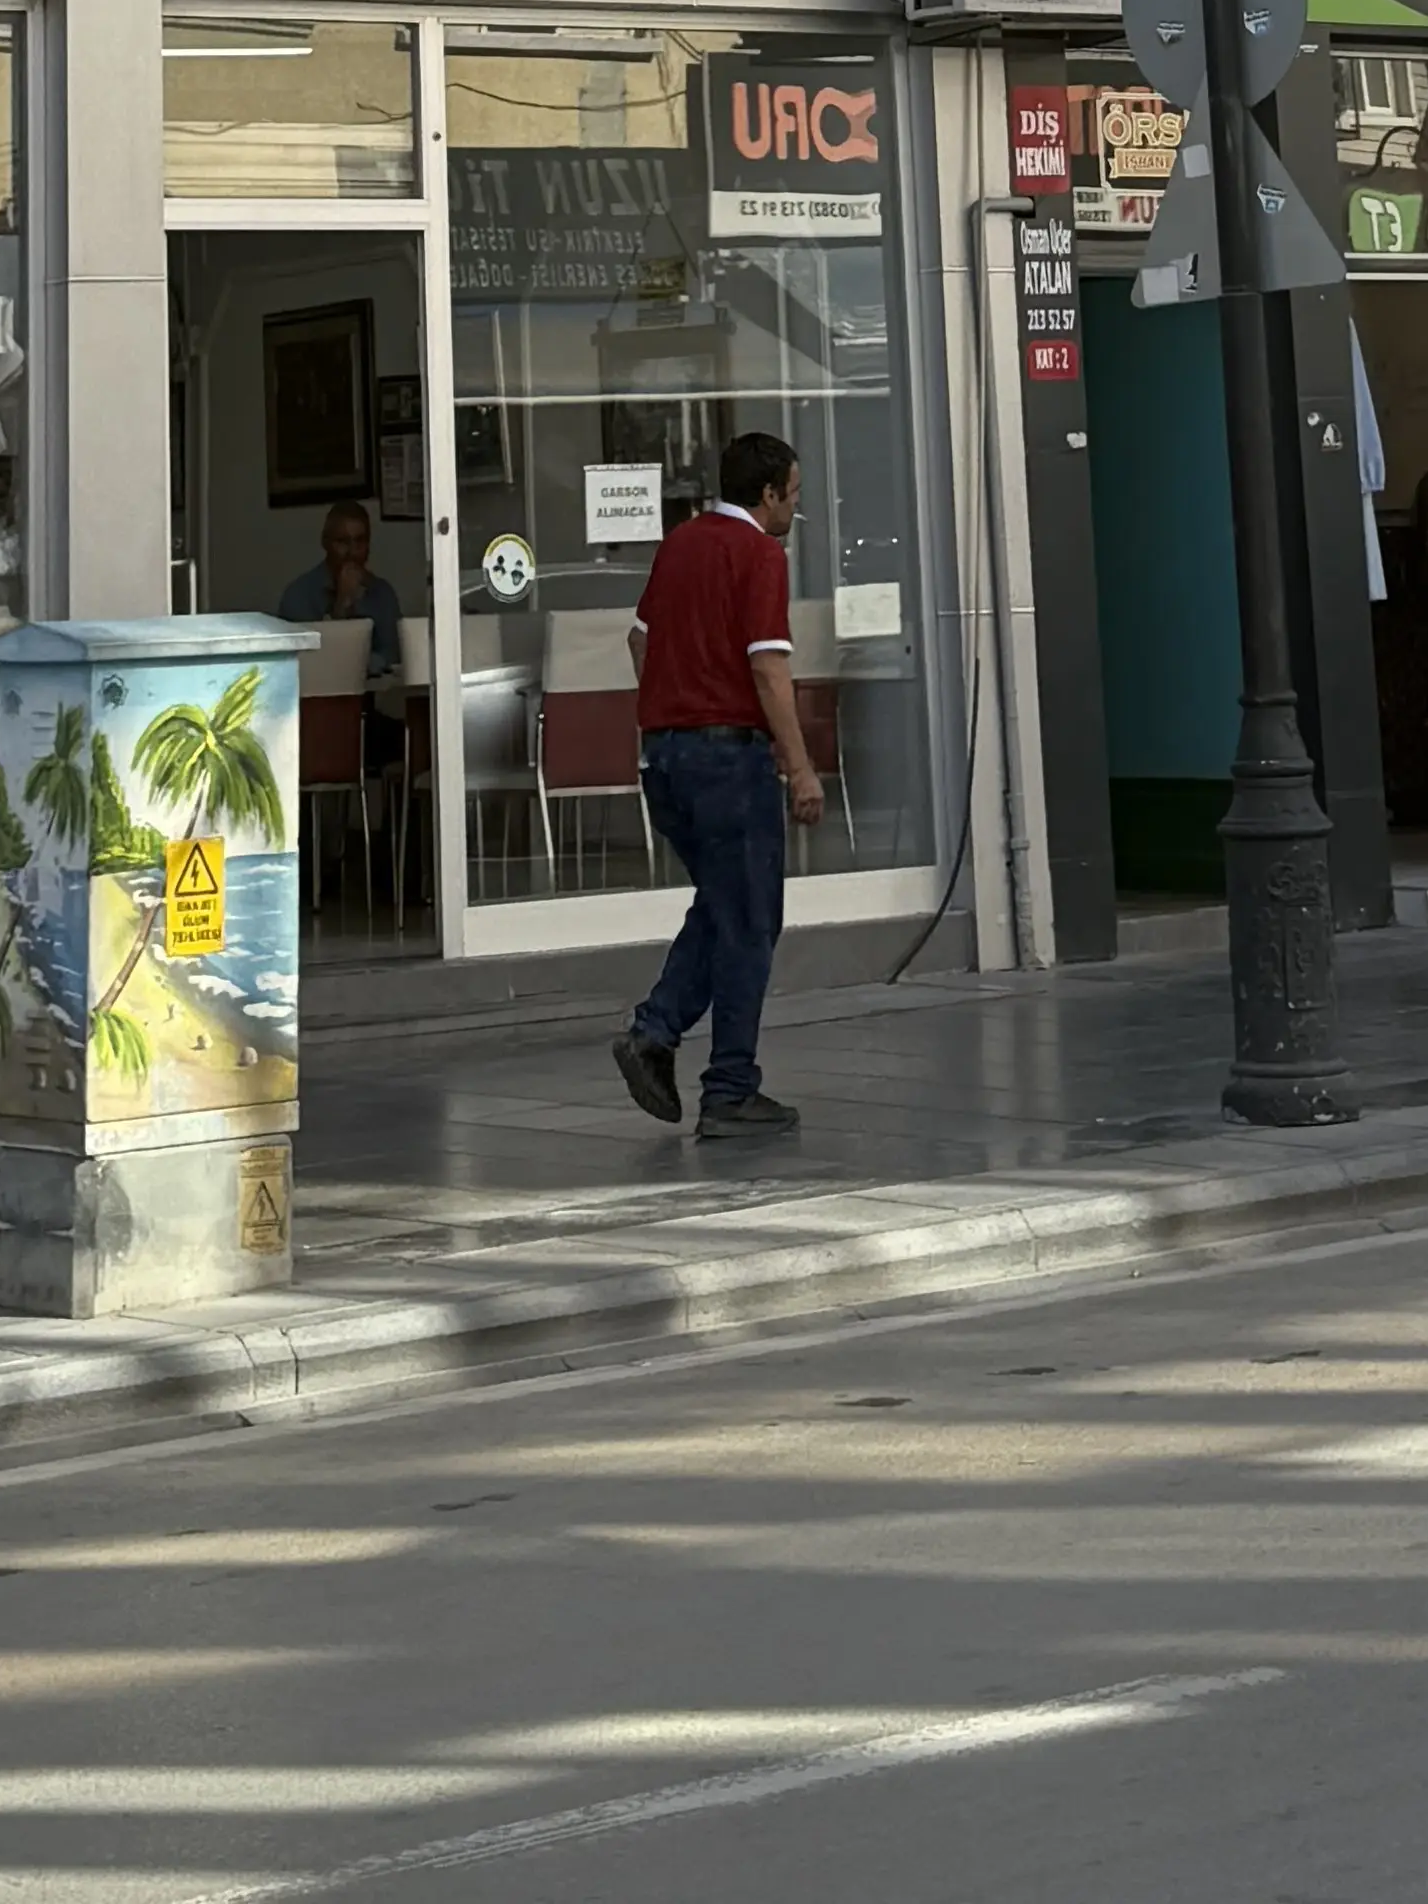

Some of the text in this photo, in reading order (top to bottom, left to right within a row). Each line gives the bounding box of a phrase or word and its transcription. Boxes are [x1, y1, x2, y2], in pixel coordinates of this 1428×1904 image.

[1020, 103, 1060, 143] DİŞ
[1103, 103, 1182, 147] ÖRS
[1015, 139, 1066, 177] HEKİMİ
[1024, 260, 1072, 295] ATALAN
[1027, 308, 1075, 330] 213 52 57
